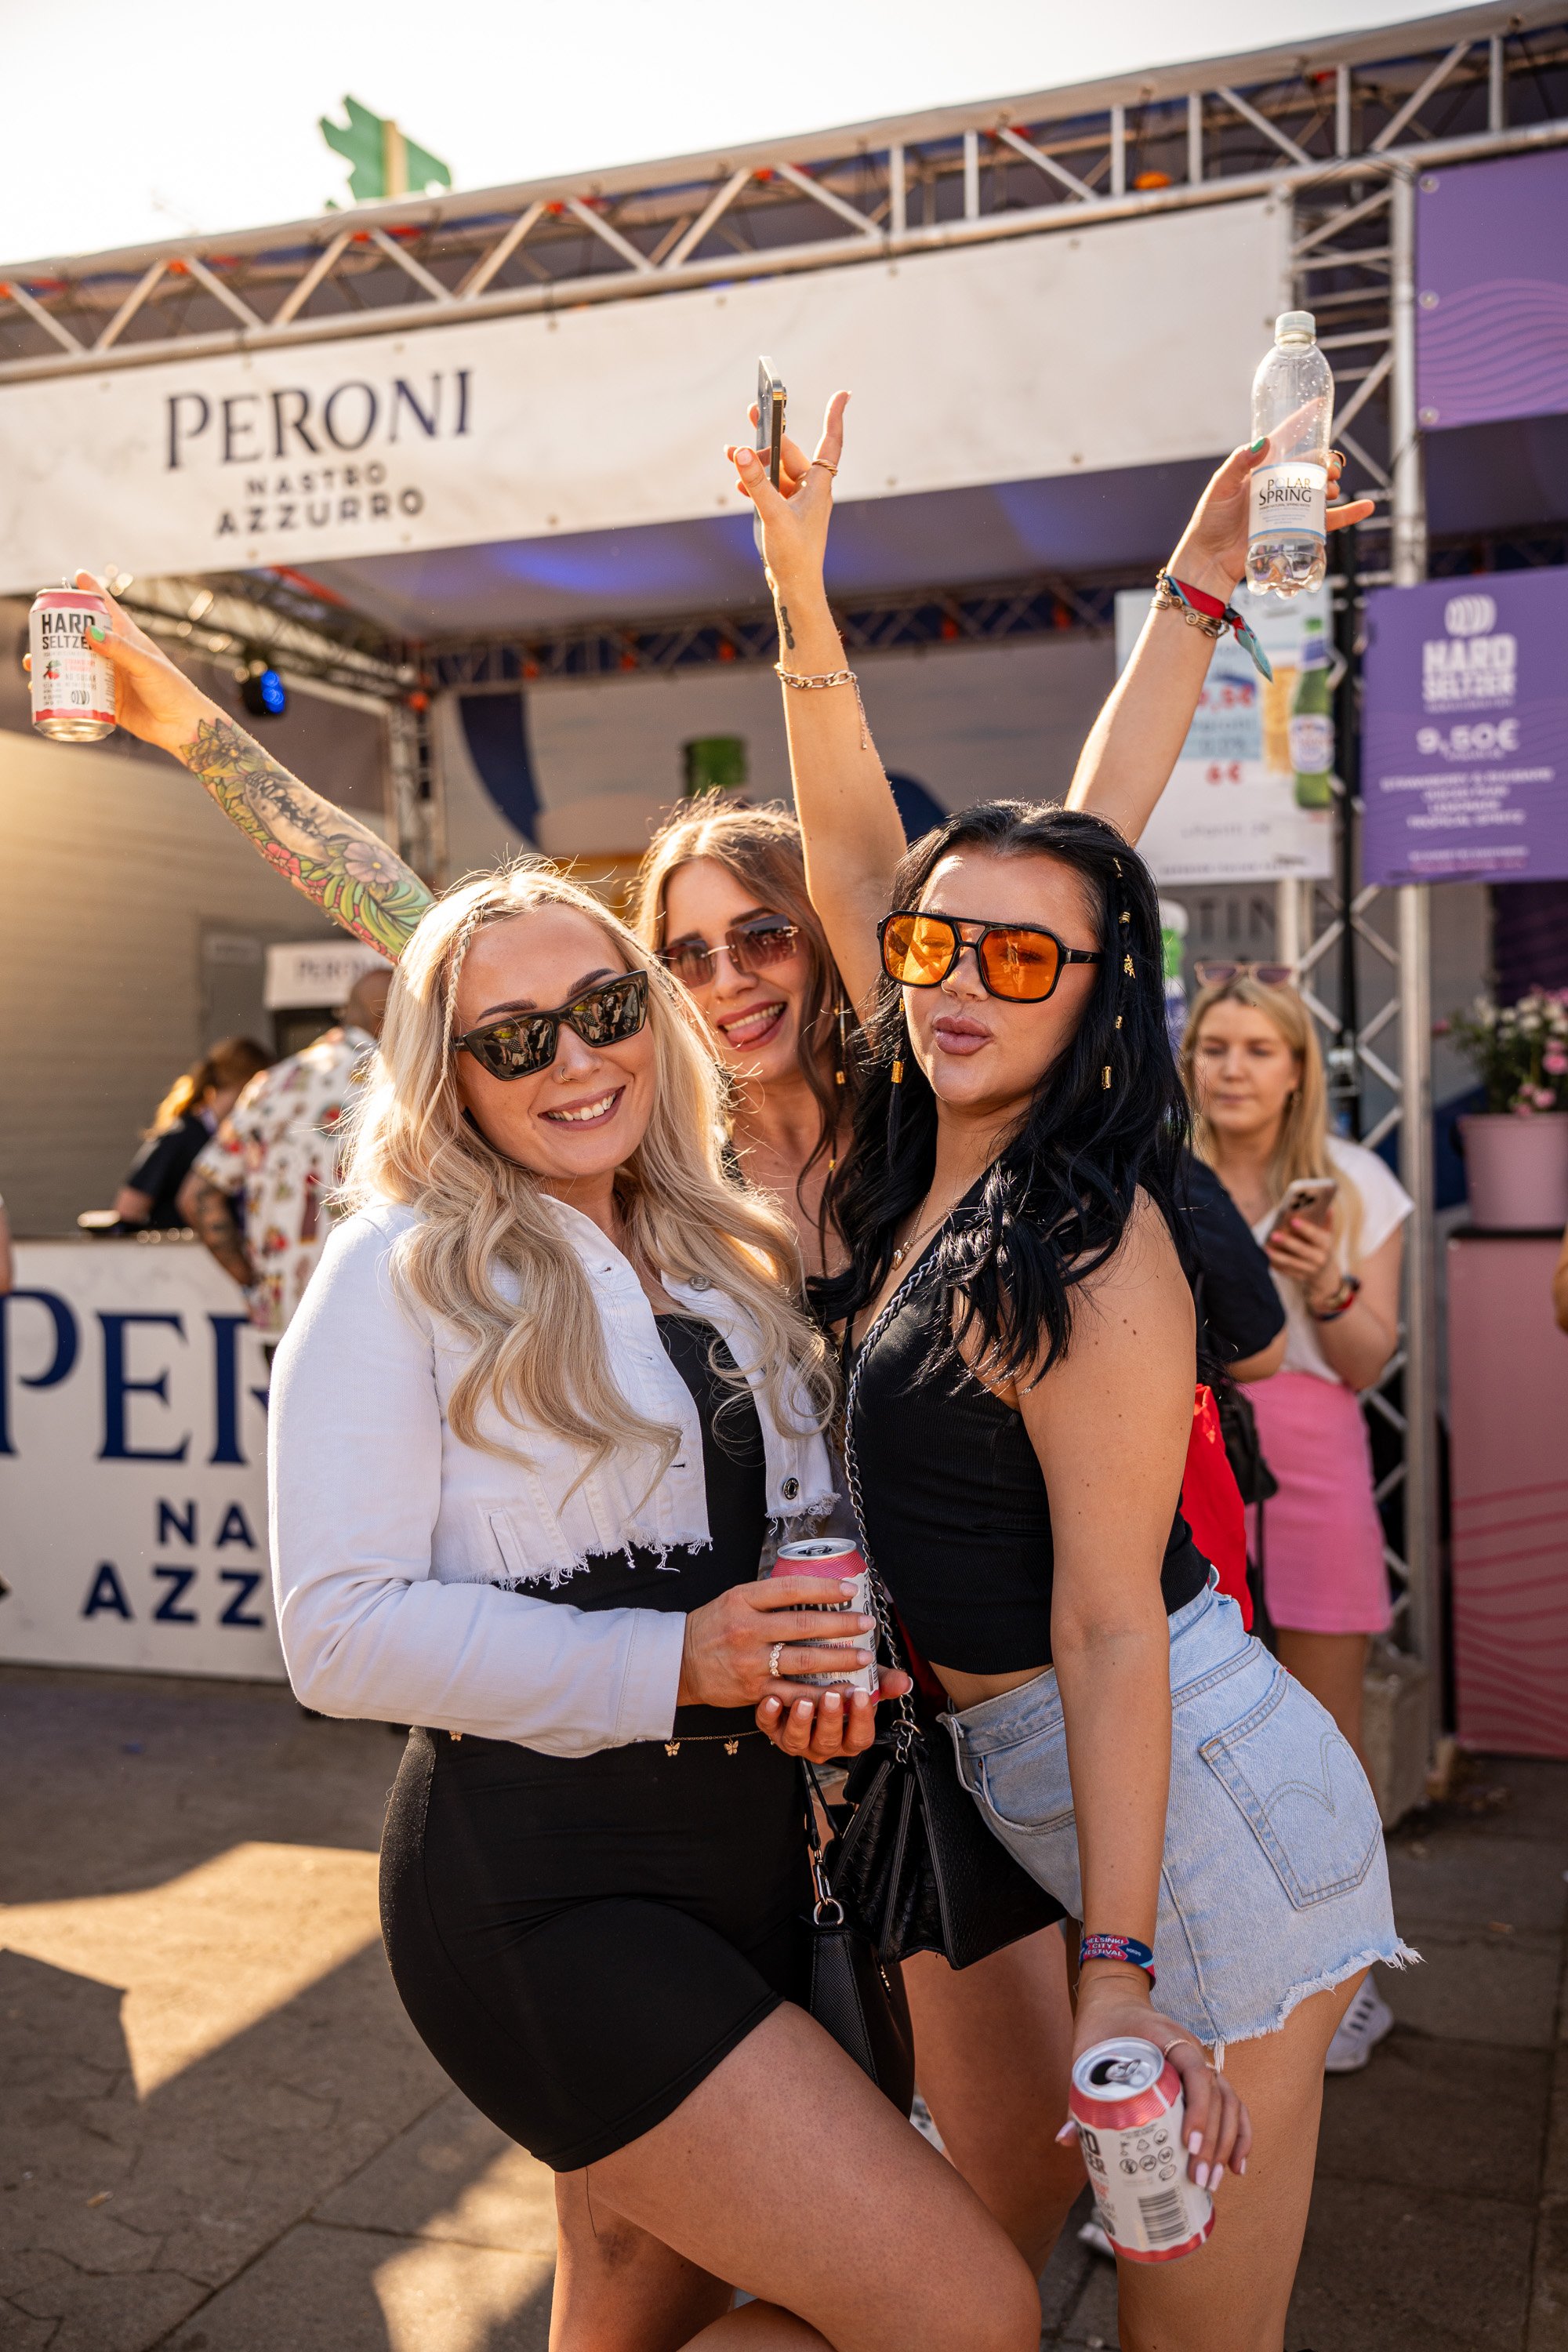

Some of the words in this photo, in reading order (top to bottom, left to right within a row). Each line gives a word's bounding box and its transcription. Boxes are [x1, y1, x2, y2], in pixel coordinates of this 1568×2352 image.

[166, 368, 472, 470] PERONI
[245, 460, 386, 496] NASTRO
[1267, 477, 1312, 491] POLAR
[216, 487, 424, 538] AZZURRO
[1258, 487, 1312, 506] SPRING
[42, 612, 96, 635] HARD
[42, 635, 93, 651] SELTZE
[1423, 633, 1517, 673] HARD
[1421, 671, 1517, 703] SELTZER
[1415, 717, 1521, 757] 9,50€
[1085, 1948, 1123, 1957] FESTIVAL
